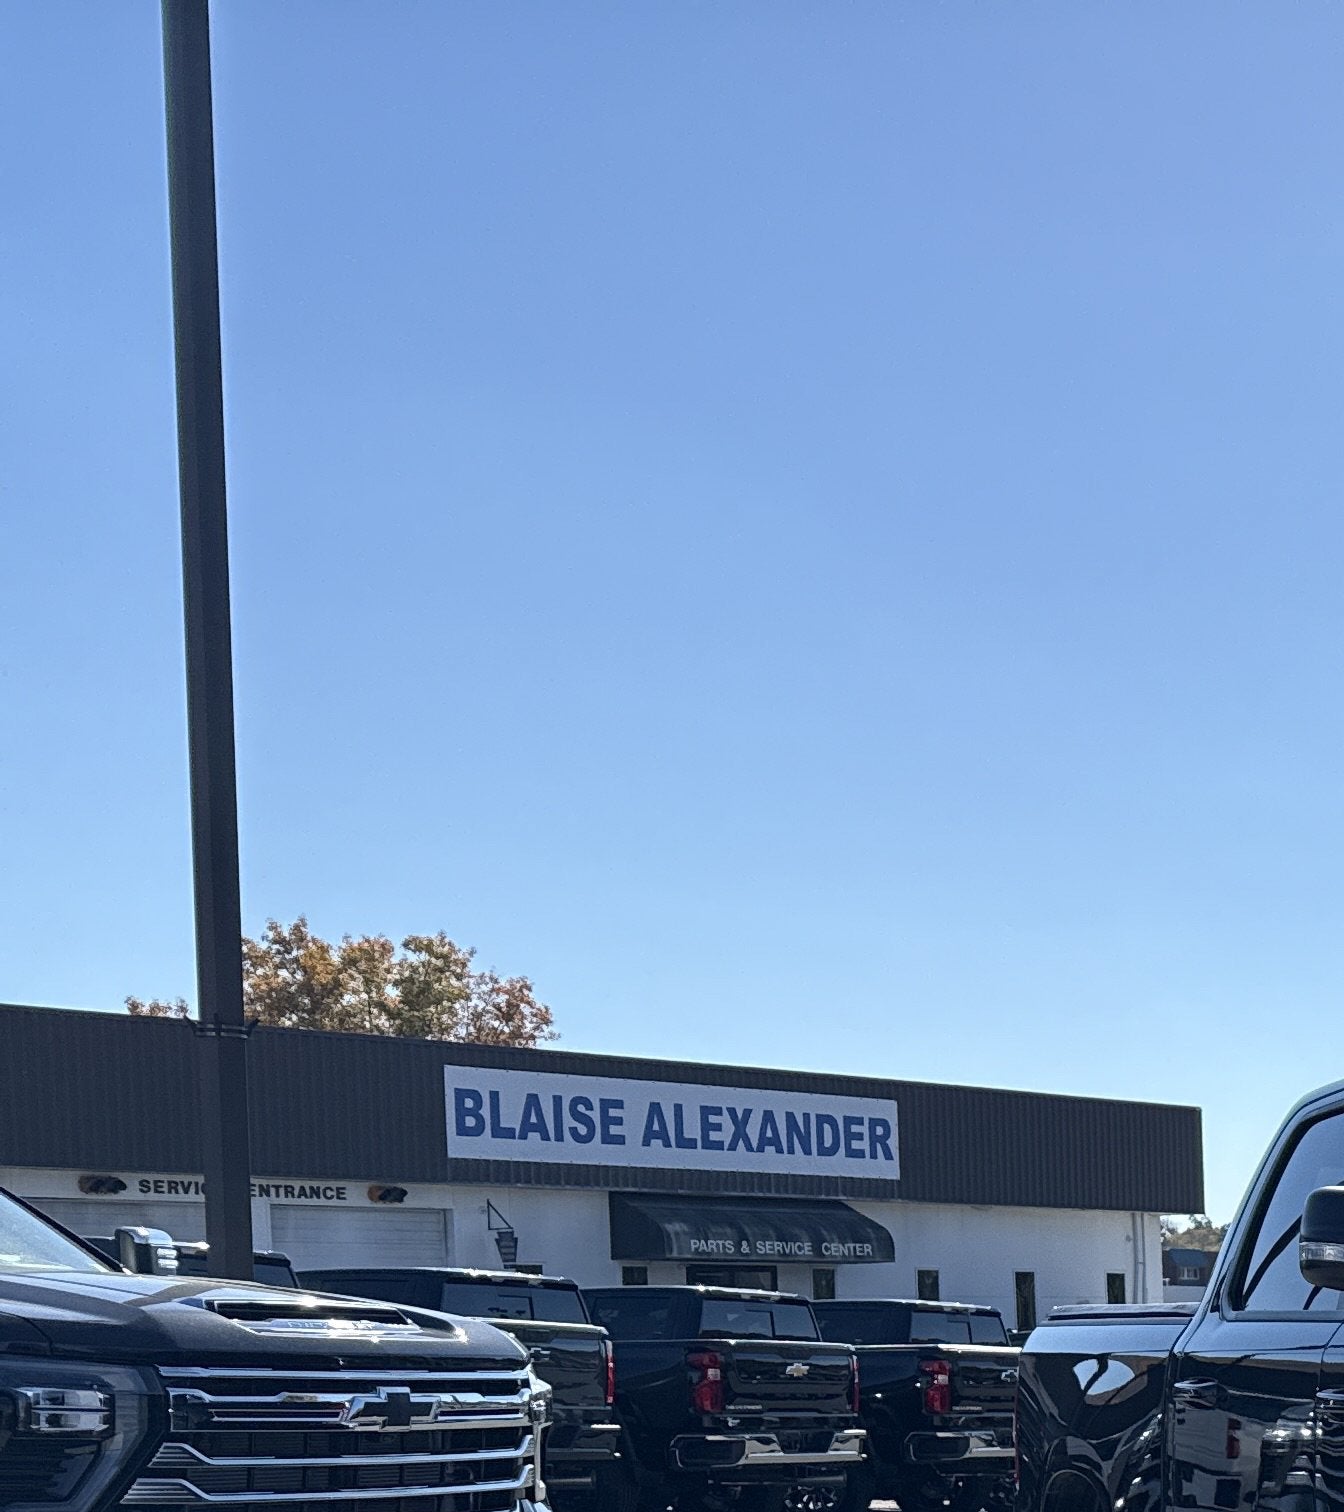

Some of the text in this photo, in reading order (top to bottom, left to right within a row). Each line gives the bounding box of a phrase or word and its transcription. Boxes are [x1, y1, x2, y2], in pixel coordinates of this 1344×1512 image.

[453, 1087, 894, 1162] BLAISE ALEXANDER
[138, 1178, 205, 1195] SERVI
[690, 1239, 873, 1256] PARTS & SERVICE CENTER
